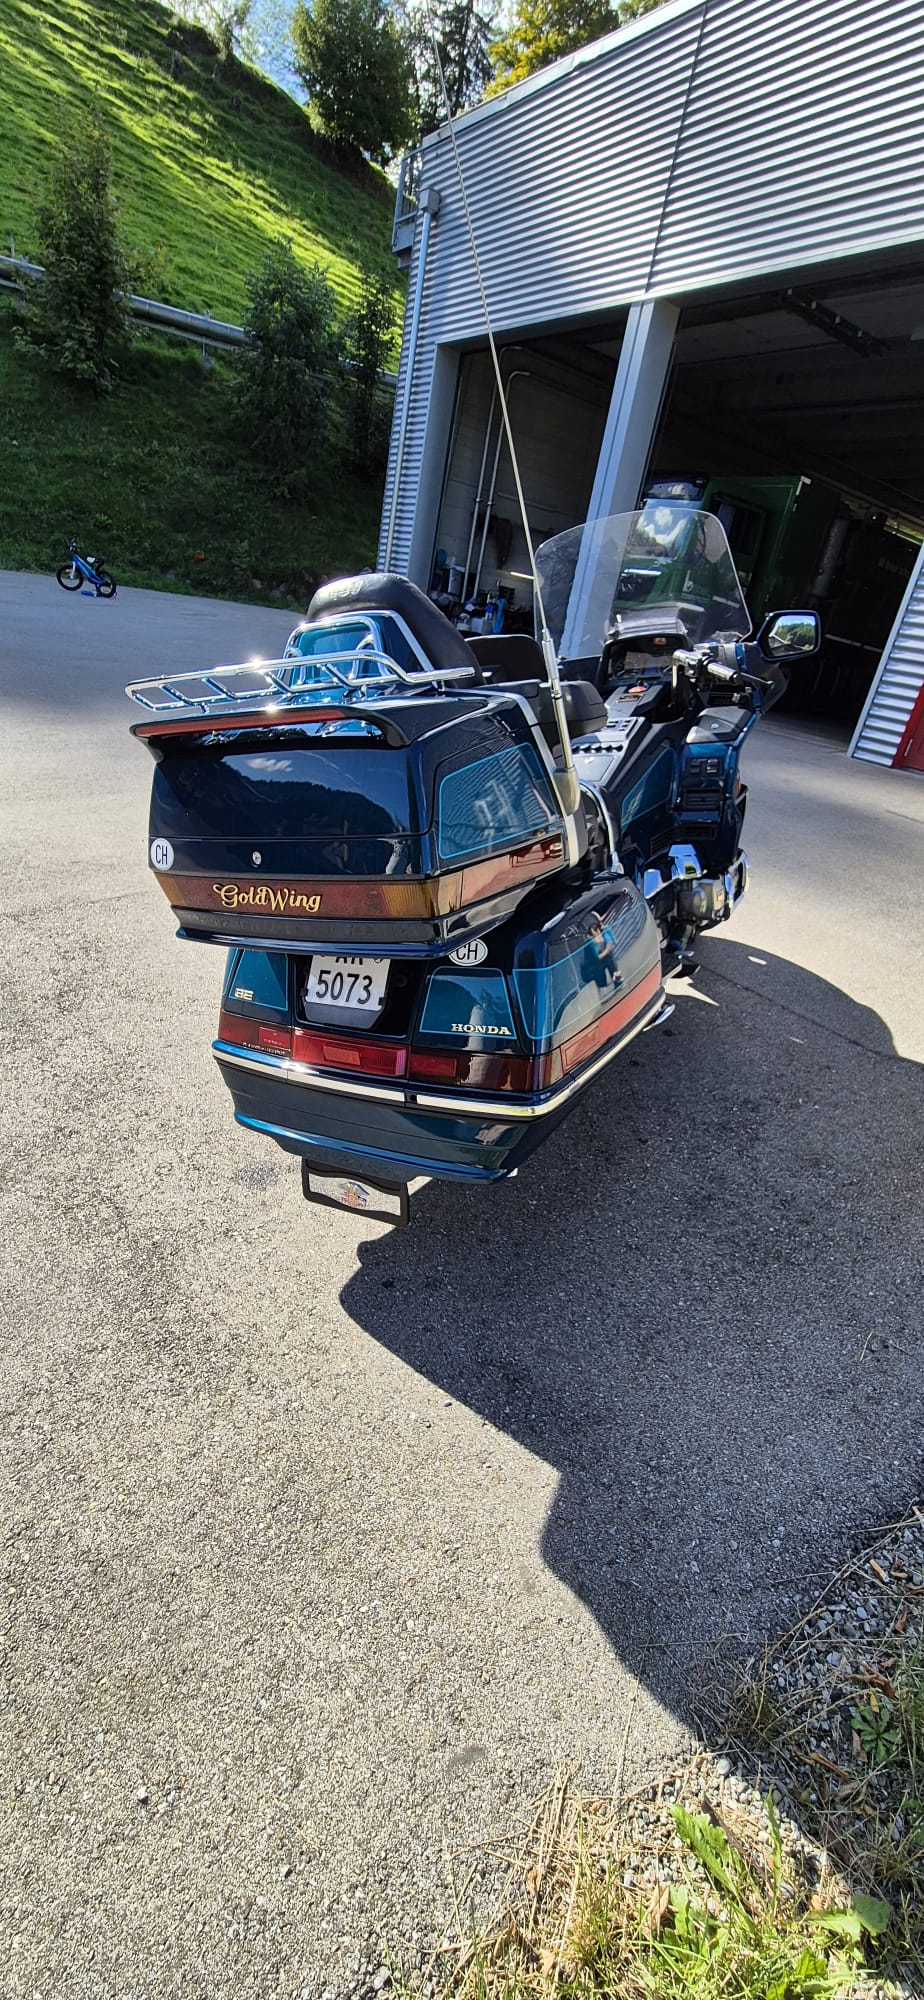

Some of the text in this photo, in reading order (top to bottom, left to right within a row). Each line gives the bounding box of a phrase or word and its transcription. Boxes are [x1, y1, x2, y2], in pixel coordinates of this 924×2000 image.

[155, 844, 168, 865] CH
[212, 884, 321, 912] GoldWing
[456, 942, 478, 961] CH
[315, 969, 373, 1005] 5073
[450, 1023, 512, 1036] HONDA
